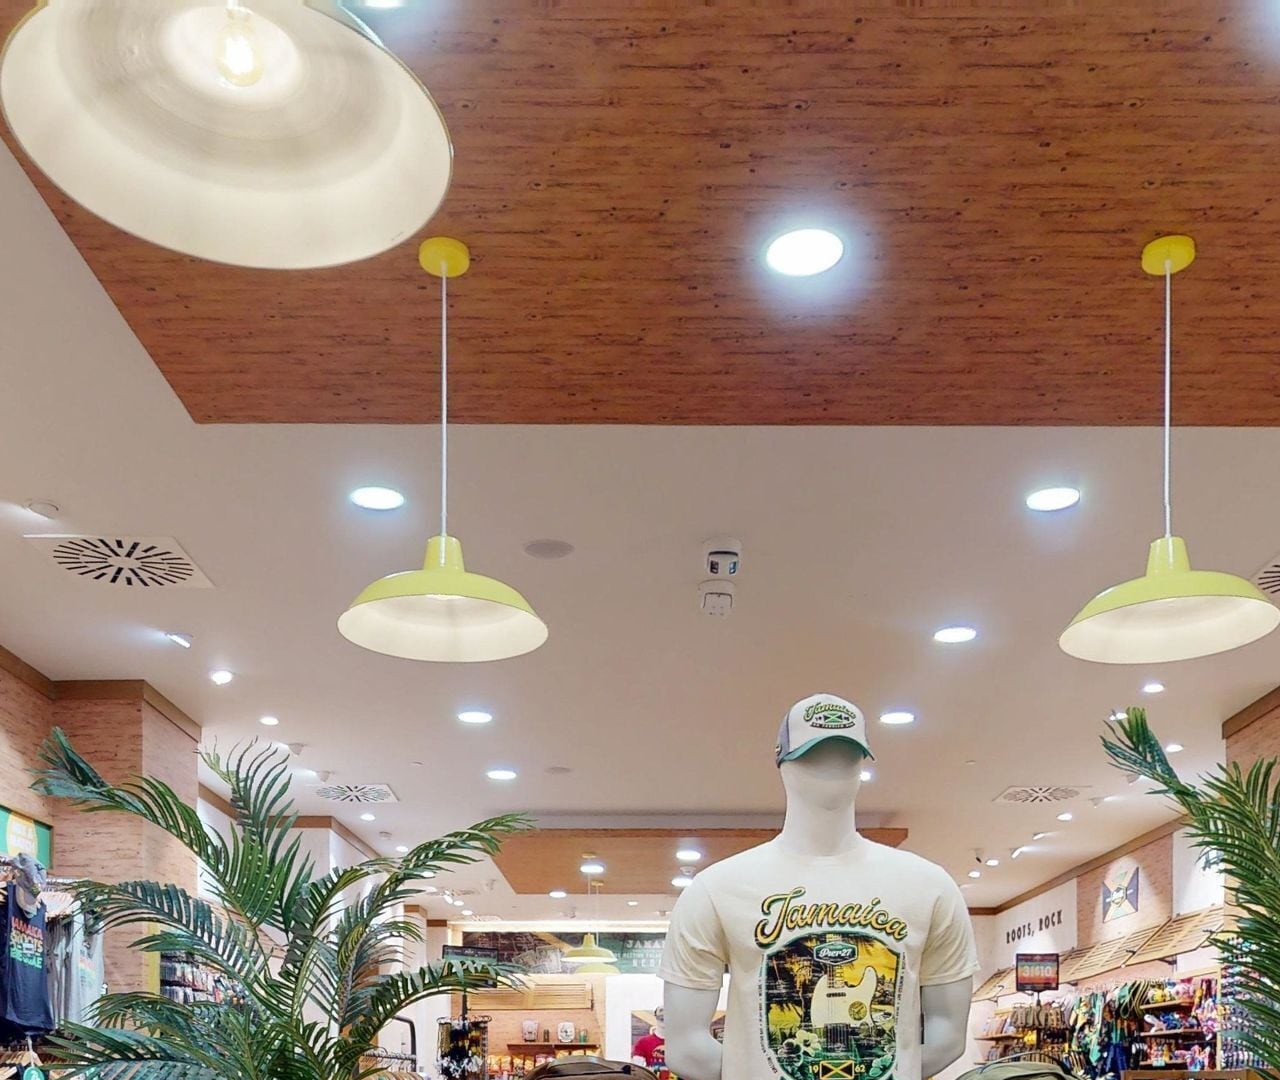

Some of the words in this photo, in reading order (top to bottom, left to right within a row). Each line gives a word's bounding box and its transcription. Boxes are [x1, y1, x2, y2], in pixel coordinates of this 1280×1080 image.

[754, 885, 911, 949] Jamaica
[1038, 909, 1063, 931] ROCK
[809, 1065, 818, 1074] 19
[855, 1064, 866, 1073] 62
